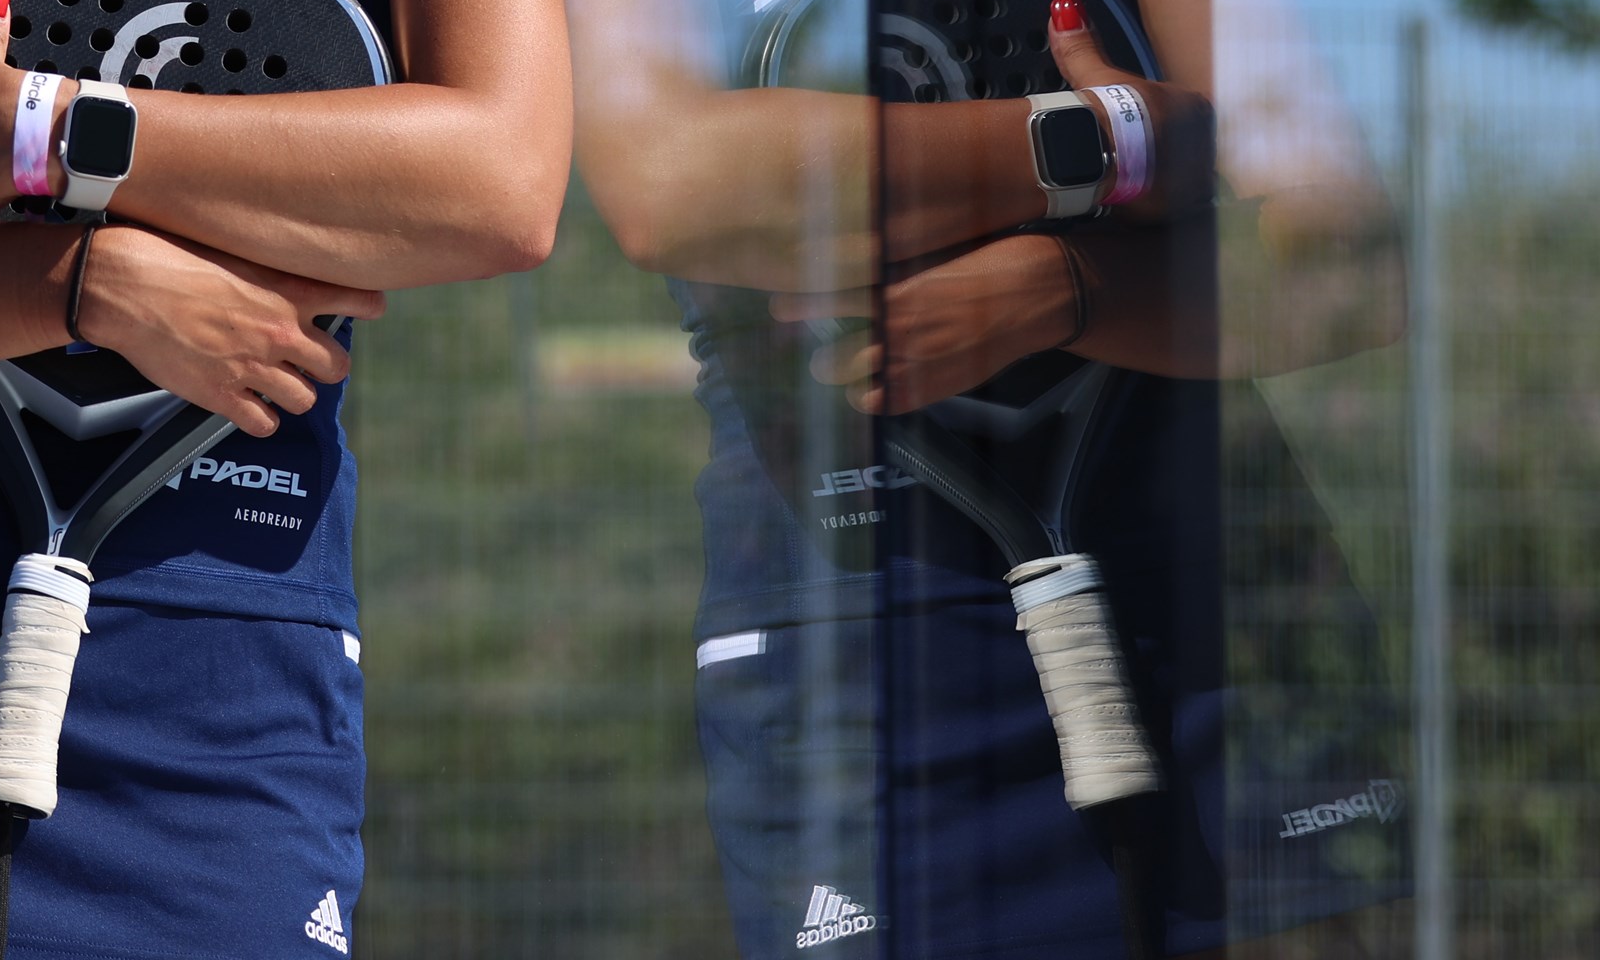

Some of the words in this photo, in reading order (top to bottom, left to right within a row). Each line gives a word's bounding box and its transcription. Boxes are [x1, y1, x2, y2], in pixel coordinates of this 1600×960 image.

[25, 74, 47, 110] Circle
[190, 457, 308, 498] PADEL
[234, 507, 303, 531] AEROREADY
[305, 921, 348, 955] adidas
